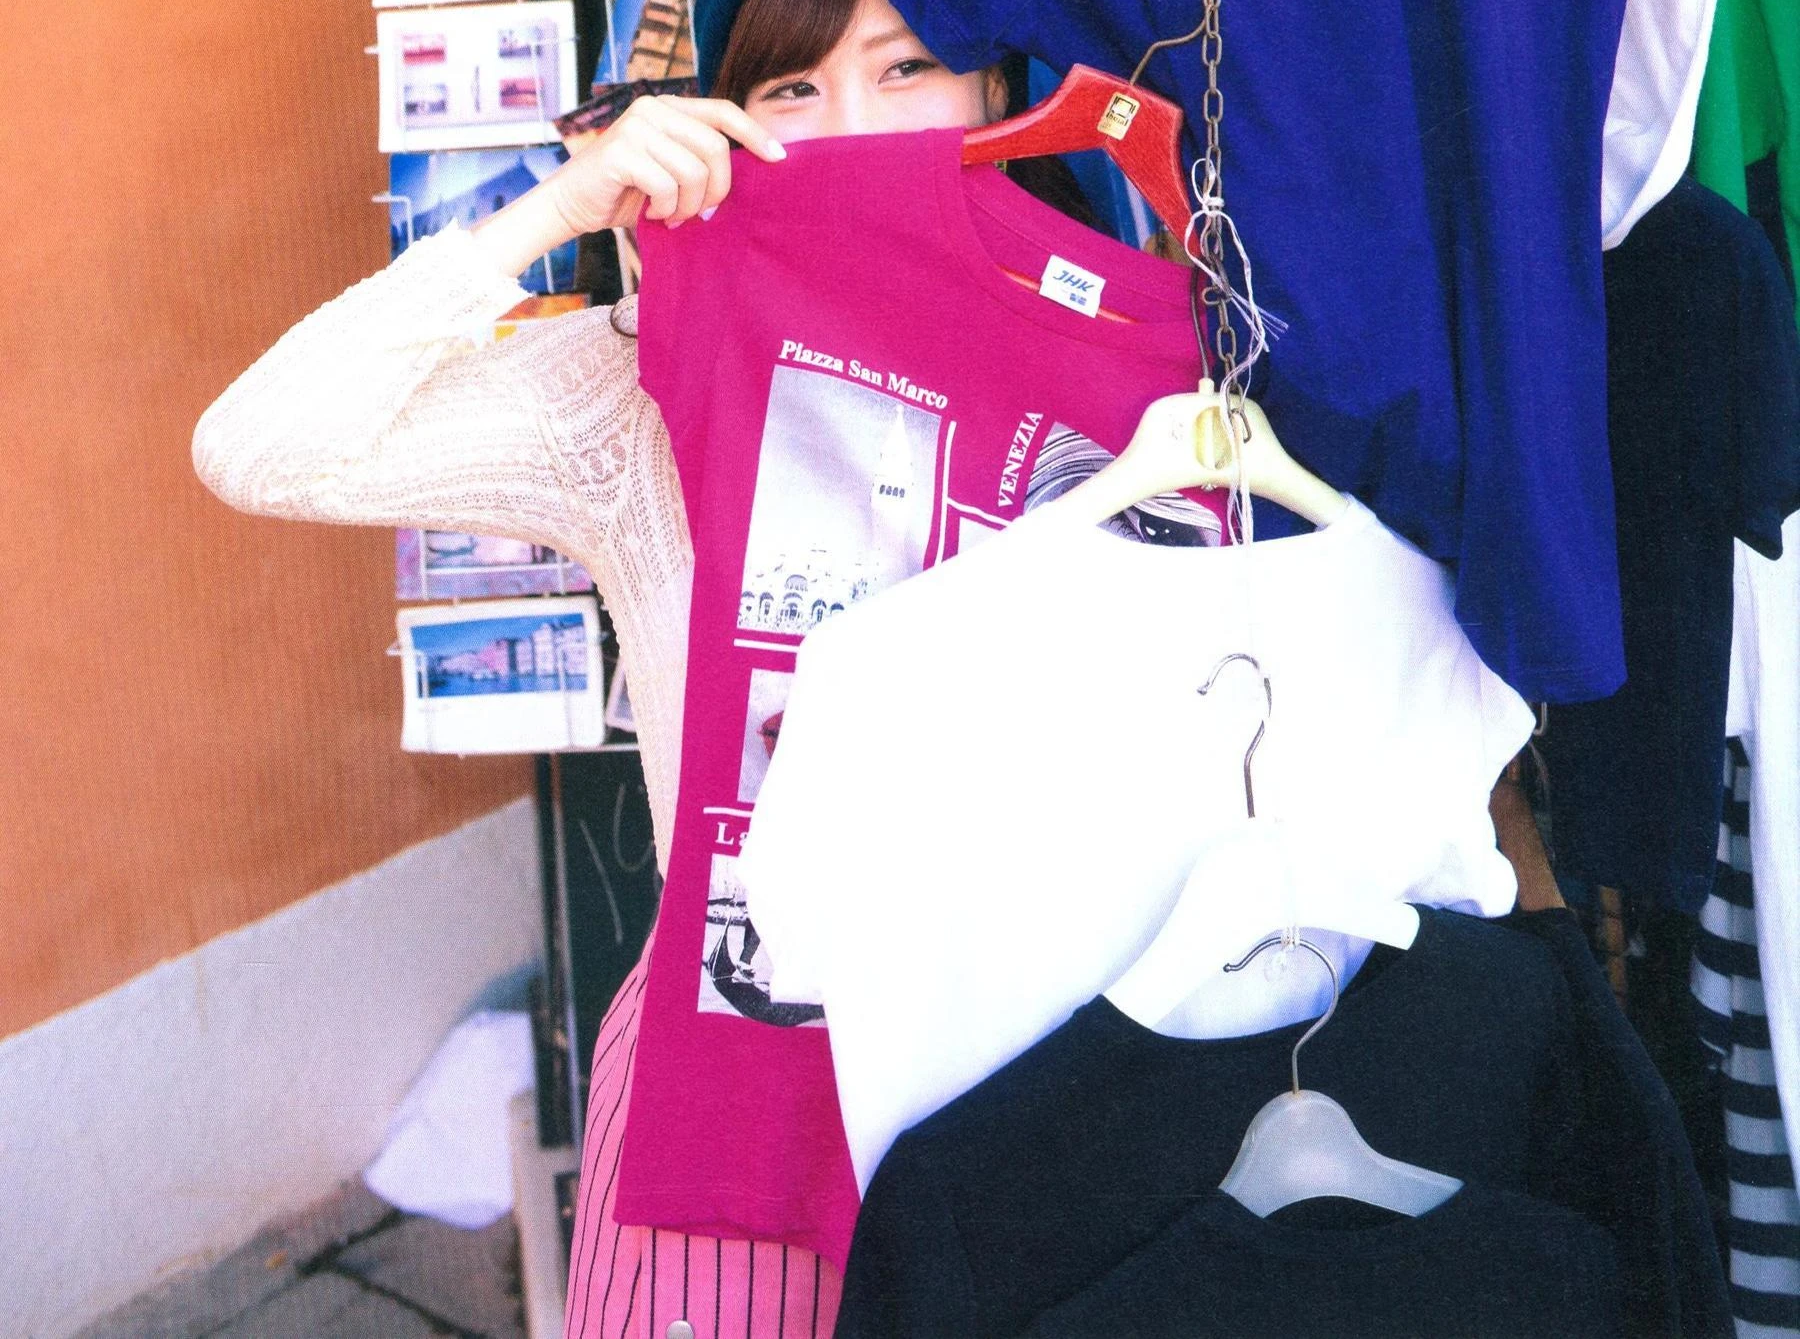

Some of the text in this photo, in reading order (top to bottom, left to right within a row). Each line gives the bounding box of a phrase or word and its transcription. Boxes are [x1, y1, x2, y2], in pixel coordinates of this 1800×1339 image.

[1052, 270, 1095, 292] JHK
[778, 339, 949, 410] Piazza San Marco
[998, 412, 1044, 507] VENEZIA
